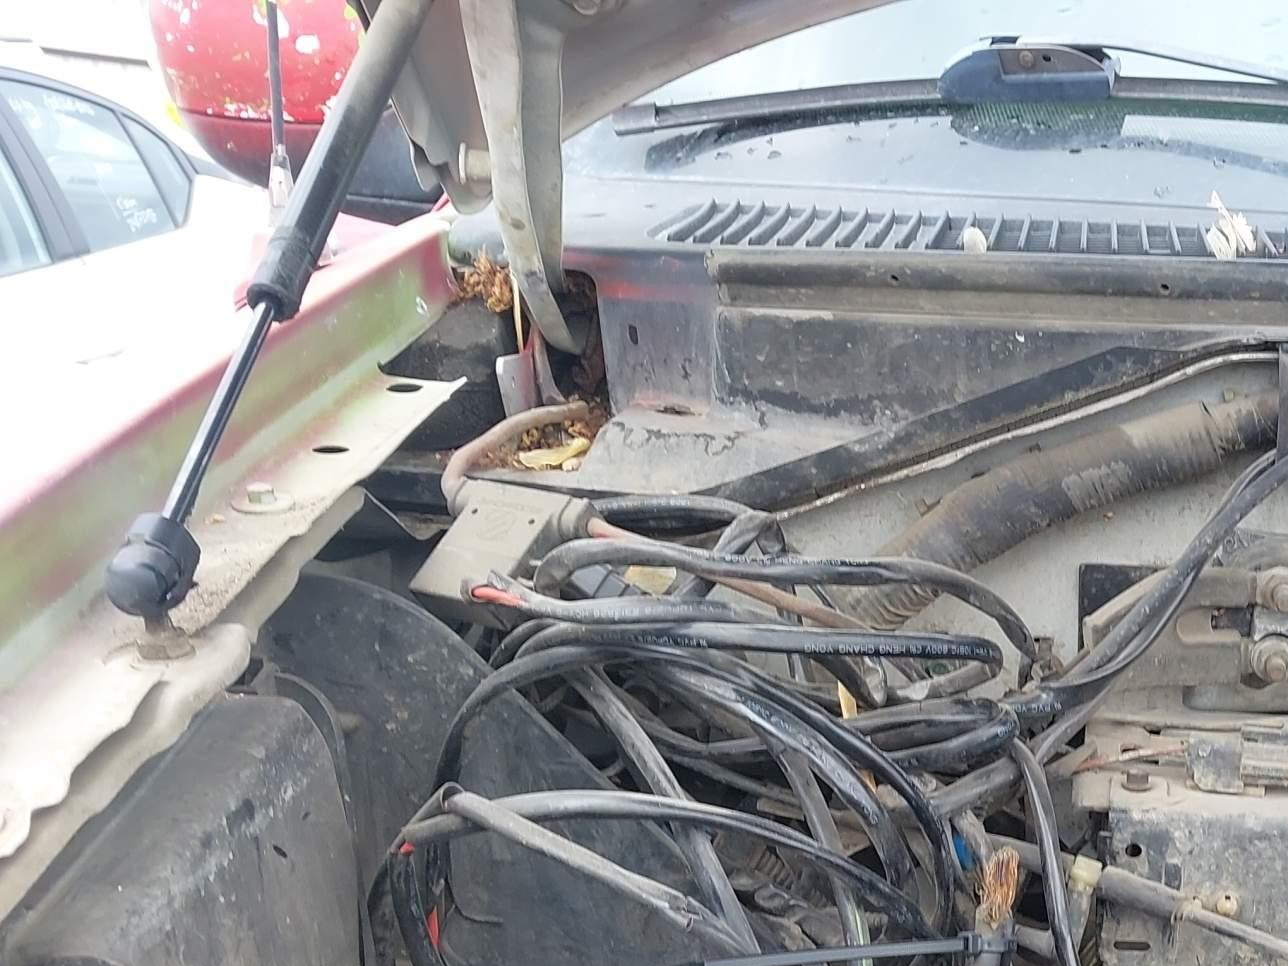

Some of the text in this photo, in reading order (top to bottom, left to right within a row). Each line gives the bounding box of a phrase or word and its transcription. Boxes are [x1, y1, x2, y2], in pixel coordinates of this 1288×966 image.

[804, 643, 834, 654] YONG
[838, 644, 876, 655] CHANG
[879, 644, 907, 655] HENG
